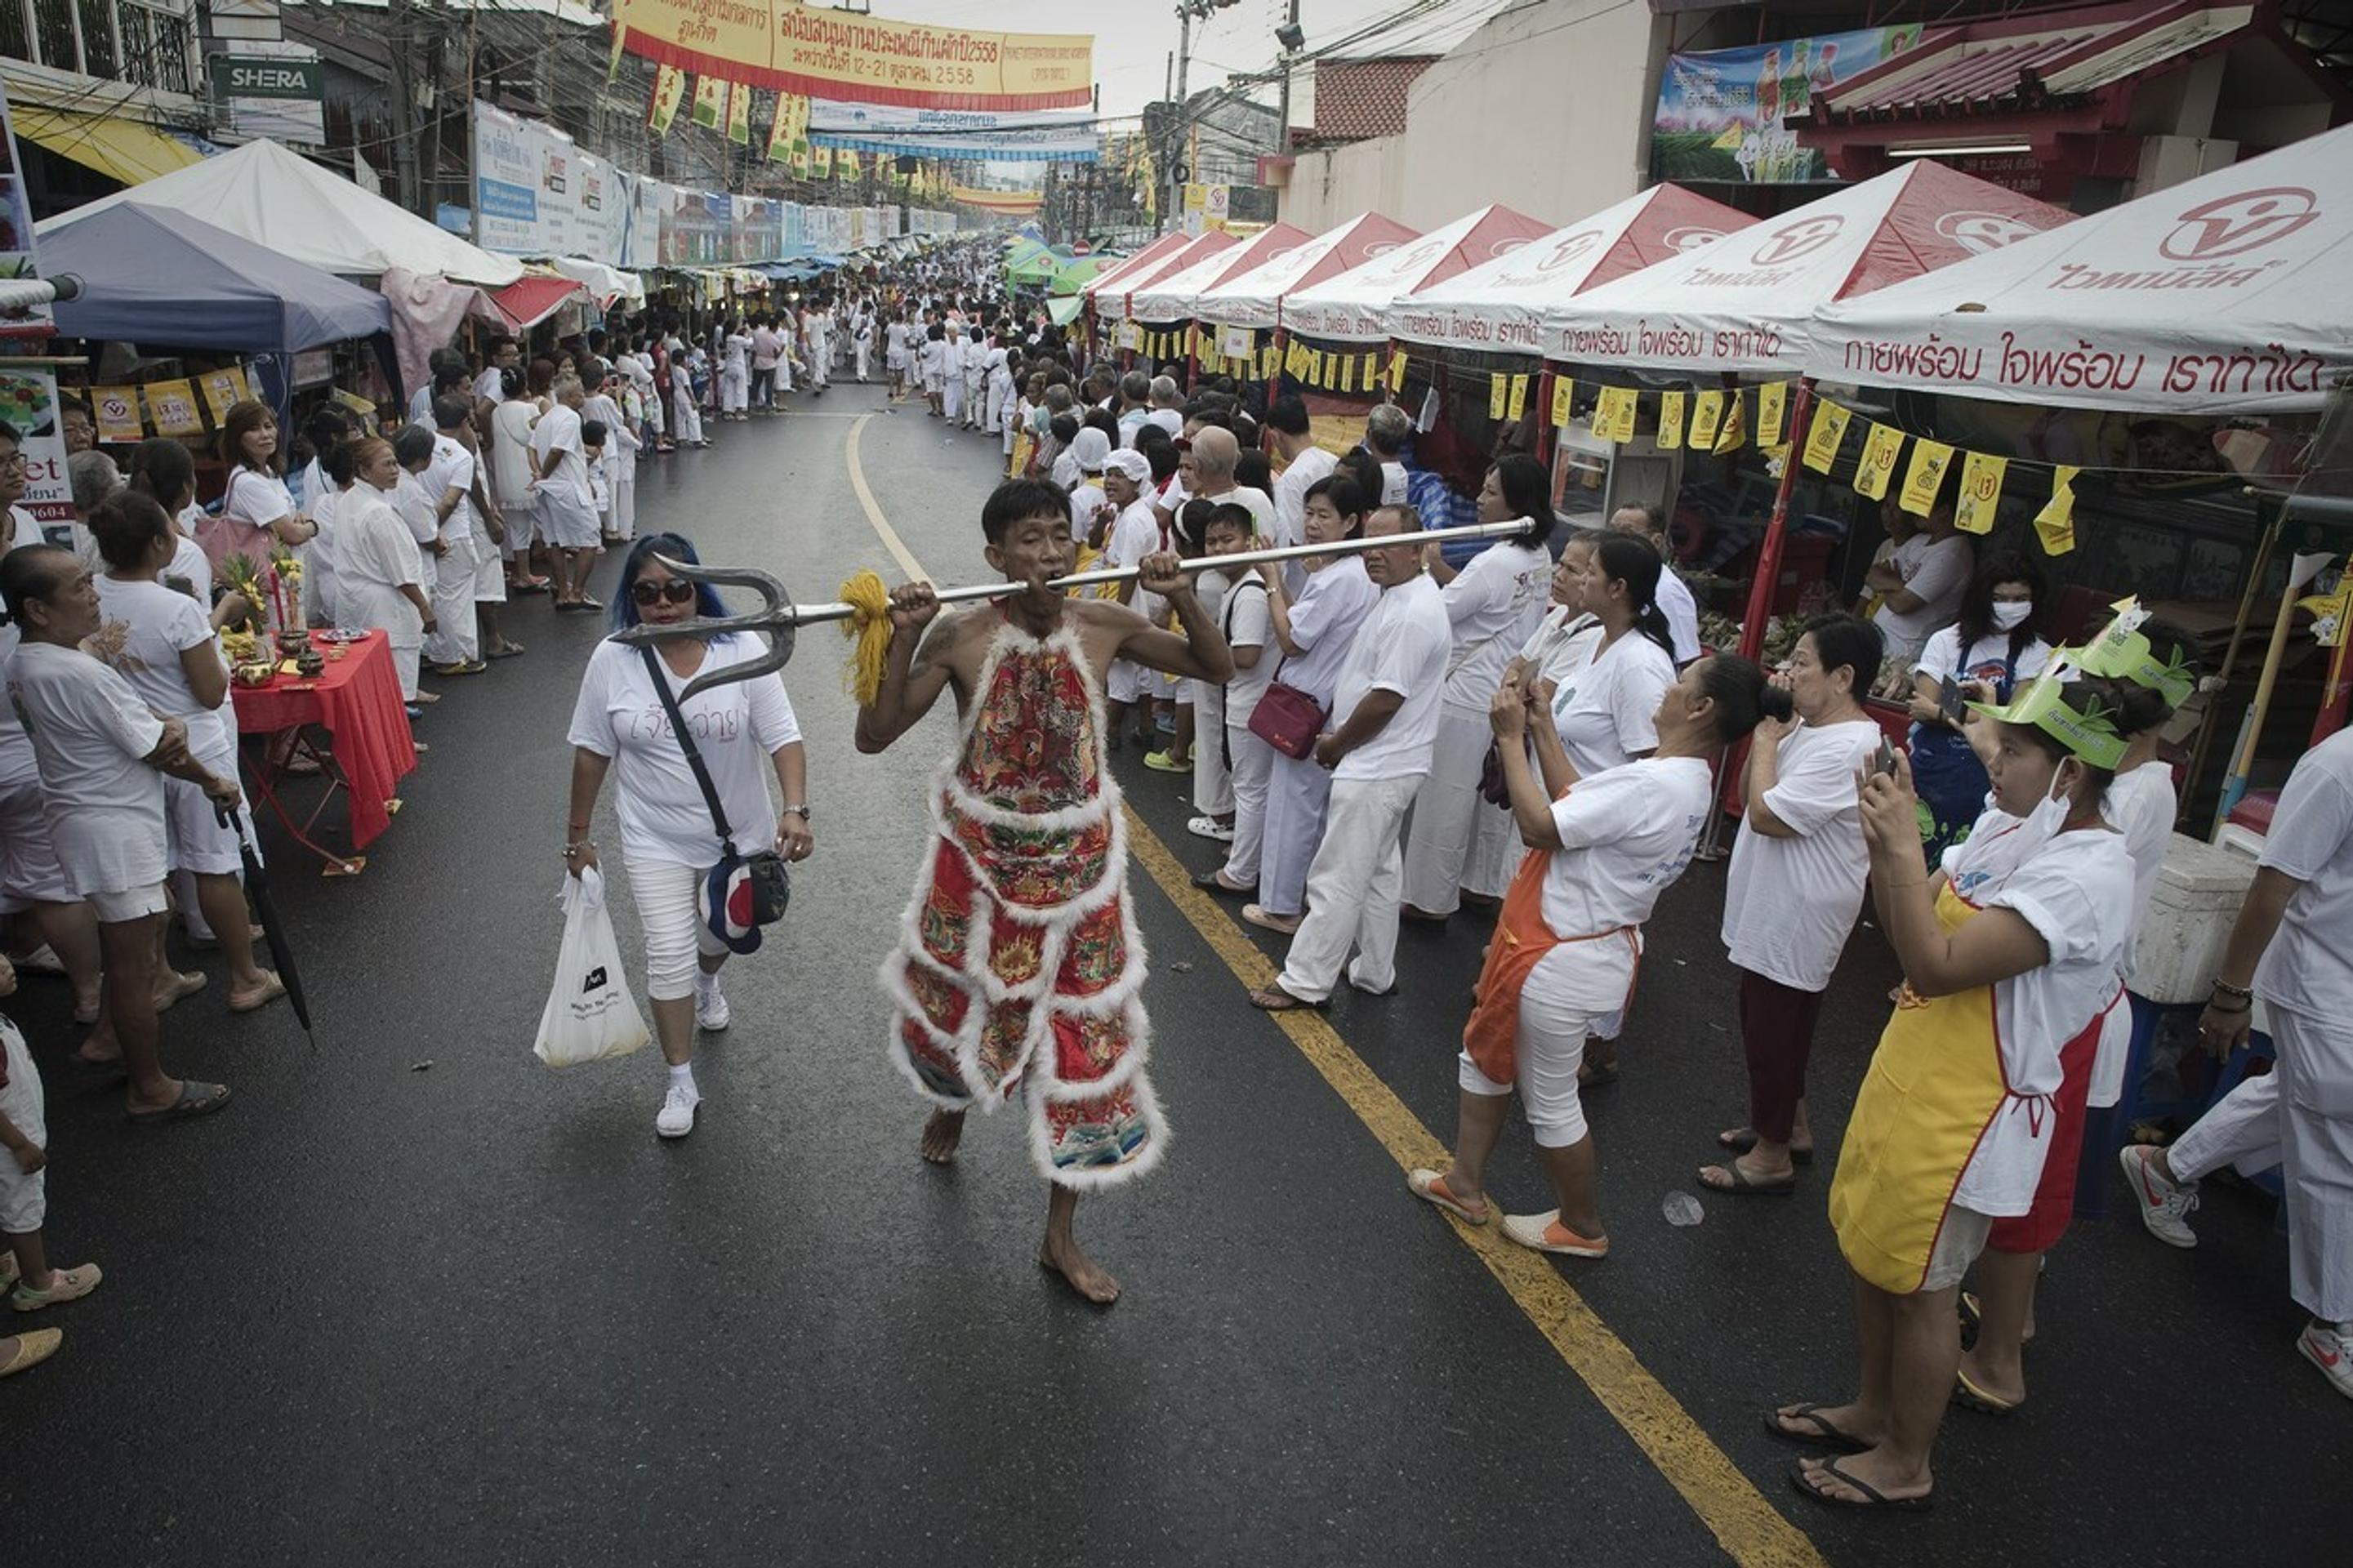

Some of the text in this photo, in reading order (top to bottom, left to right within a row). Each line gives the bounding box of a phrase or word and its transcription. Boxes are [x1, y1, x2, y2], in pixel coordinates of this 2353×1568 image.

[232, 68, 308, 88] SHERA
[792, 47, 850, 74] ระหว่างวันที่
[889, 63, 931, 84] ตุลาคม
[935, 66, 975, 85] 2558
[1402, 310, 1446, 336] กายพร้อม
[1451, 310, 1492, 340] ใจพร้อม
[1562, 318, 1784, 358] กายพร้อม ใจพร้อม เราทำได้
[1844, 331, 2325, 394] กายพร้อม ใจพร้อม เราทำได้
